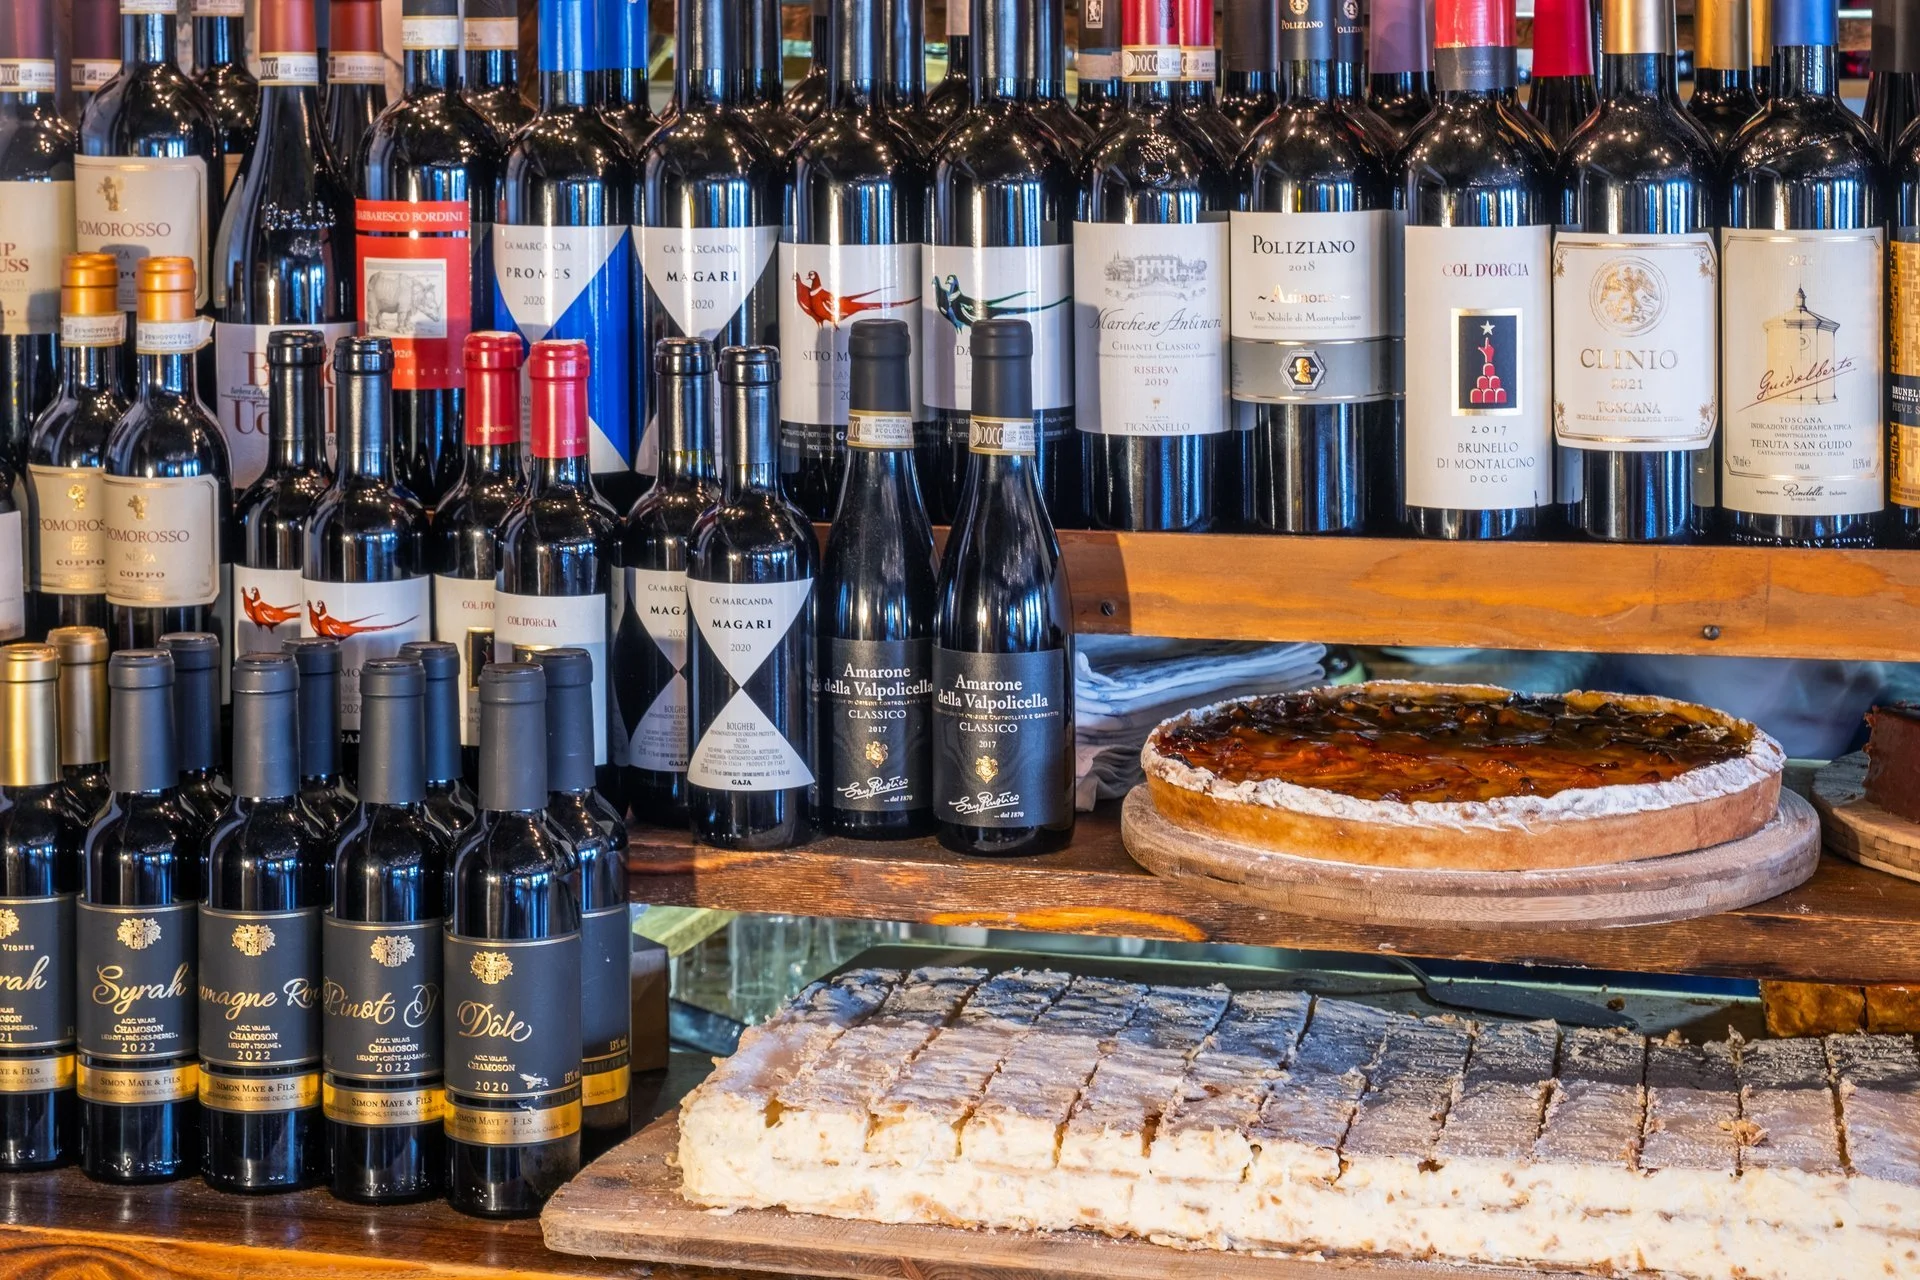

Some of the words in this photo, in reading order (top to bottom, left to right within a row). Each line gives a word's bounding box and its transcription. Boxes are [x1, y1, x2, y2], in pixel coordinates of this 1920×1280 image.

[1281, 19, 1324, 31] POLIZIANO
[1135, 53, 1157, 72] DOCG
[412, 210, 464, 222] BORDINI
[679, 244, 740, 254] MRCANDA
[1252, 234, 1356, 255] POLIZIANO
[1288, 260, 1316, 272] 2018
[1442, 263, 1473, 278] COL
[1475, 263, 1530, 278] D'ORCIA
[666, 270, 738, 283] MAGARI
[523, 295, 545, 306] 2020
[1088, 306, 1161, 332] Marchese
[1149, 307, 1224, 338] Antinori
[1267, 311, 1293, 322] Nobile
[1295, 312, 1303, 322] di
[1305, 311, 1362, 325] Montepulciano
[1111, 340, 1152, 351] CHIANTI
[1155, 340, 1201, 351] CLASSICO
[802, 350, 831, 362] SITO
[1580, 348, 1679, 370] CLINIO
[1134, 366, 1179, 374] RISERVA
[1144, 378, 1169, 387] 2019
[1611, 378, 1644, 390] 2021
[1757, 356, 1857, 400] Guidalberto
[1596, 400, 1662, 414] TOSCANA
[1779, 416, 1823, 424] TOSCANA
[1124, 422, 1191, 433] TIGNANELLO
[1471, 425, 1508, 435] 2017
[1790, 423, 1832, 431] GEOGRAFICA
[1457, 441, 1519, 454] BRUNELLO
[1750, 438, 1790, 450] TENUTA
[1793, 440, 1816, 450] SAN
[1818, 440, 1853, 450] GUIDO
[1436, 457, 1450, 470] DI
[1454, 456, 1535, 471] MONTALCINO
[1469, 474, 1509, 483] DOCG
[106, 526, 190, 543] POMOROSSO
[56, 558, 106, 567] COPPO
[119, 569, 165, 579] COPPO
[462, 600, 479, 610] COL
[709, 596, 722, 605] CA'
[721, 597, 774, 606] MARCANDA
[507, 615, 522, 626] COL
[522, 616, 557, 628] D'ORCIA
[711, 618, 772, 630] MAGARI
[730, 643, 752, 653] 2020
[843, 662, 911, 679] Amarone
[954, 673, 1023, 691] Amarone
[824, 677, 851, 696] della
[854, 678, 933, 701] Valpolicella
[937, 688, 962, 708] della
[964, 692, 1049, 714] Valpolicella
[848, 709, 907, 720] CLASSICO
[726, 721, 756, 732] BOLGHERI
[868, 725, 888, 734] 2017
[959, 721, 1018, 734] CLASSICO
[978, 740, 997, 749] 2017
[92, 962, 189, 1015] Syrah
[322, 975, 396, 1025] Pinot
[457, 1000, 533, 1043] Dôle
[113, 1024, 164, 1034] CHAMOSON
[229, 1031, 279, 1041] CHAMOSON
[121, 1042, 156, 1053] 2022
[368, 1043, 420, 1054] CHAMOSON
[237, 1050, 271, 1061] 2022
[488, 1054, 508, 1063] VALAIS
[21, 1067, 41, 1075] FILS
[375, 1062, 411, 1073] 2022
[467, 1061, 517, 1072] CHAMOSON
[100, 1077, 126, 1086] SIMON
[127, 1078, 153, 1087] MAYE
[153, 1077, 161, 1087] &
[163, 1075, 181, 1085] FILS
[474, 1080, 510, 1092] 2020
[215, 1082, 240, 1092] SIMON
[241, 1084, 266, 1093] MAYE
[276, 1083, 296, 1092] FILS
[351, 1097, 379, 1107] SIMON
[380, 1099, 406, 1108] MAYE
[406, 1099, 413, 1107] &
[415, 1095, 433, 1105] FILS
[455, 1112, 477, 1124] SIMON
